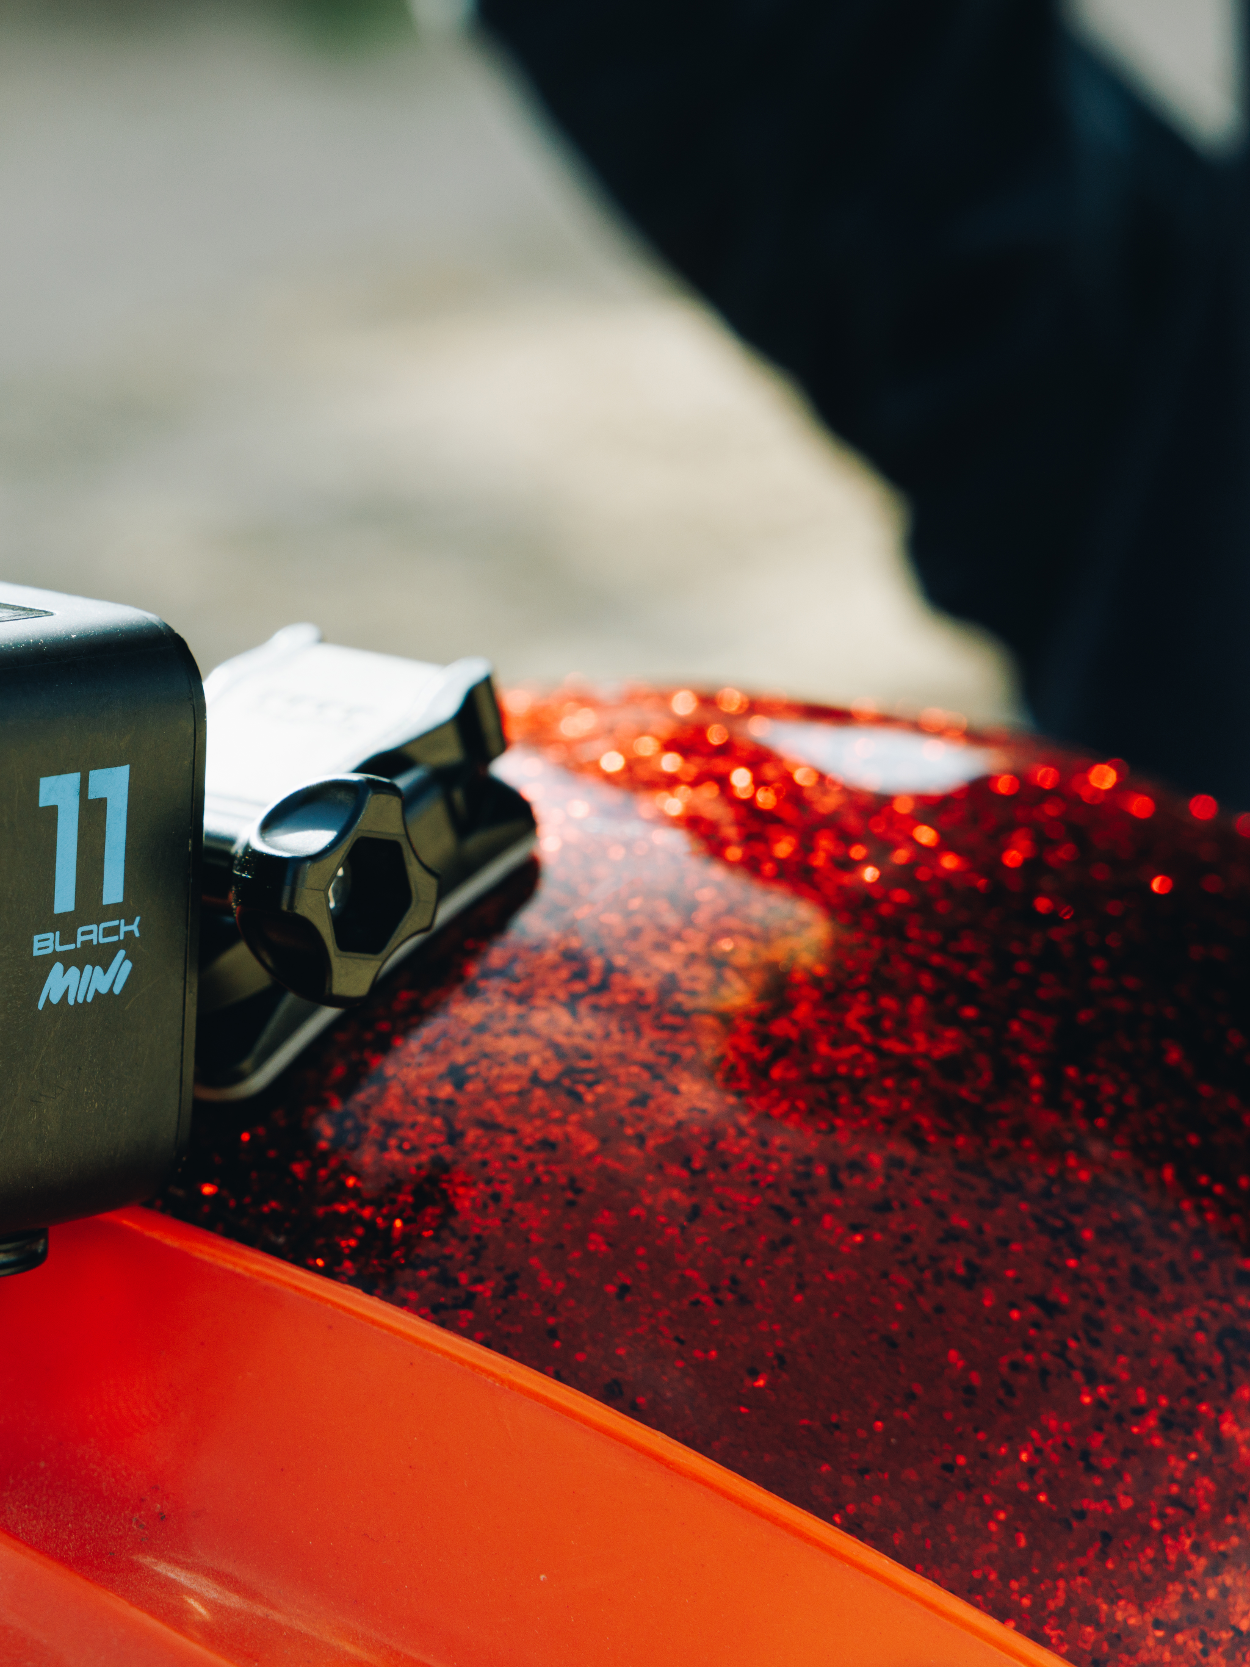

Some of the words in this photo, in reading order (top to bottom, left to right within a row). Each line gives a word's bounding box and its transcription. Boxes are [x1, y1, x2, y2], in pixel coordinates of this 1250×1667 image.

[38, 763, 131, 915] 11
[32, 915, 141, 957] BLACK
[37, 948, 133, 1011] MINI
